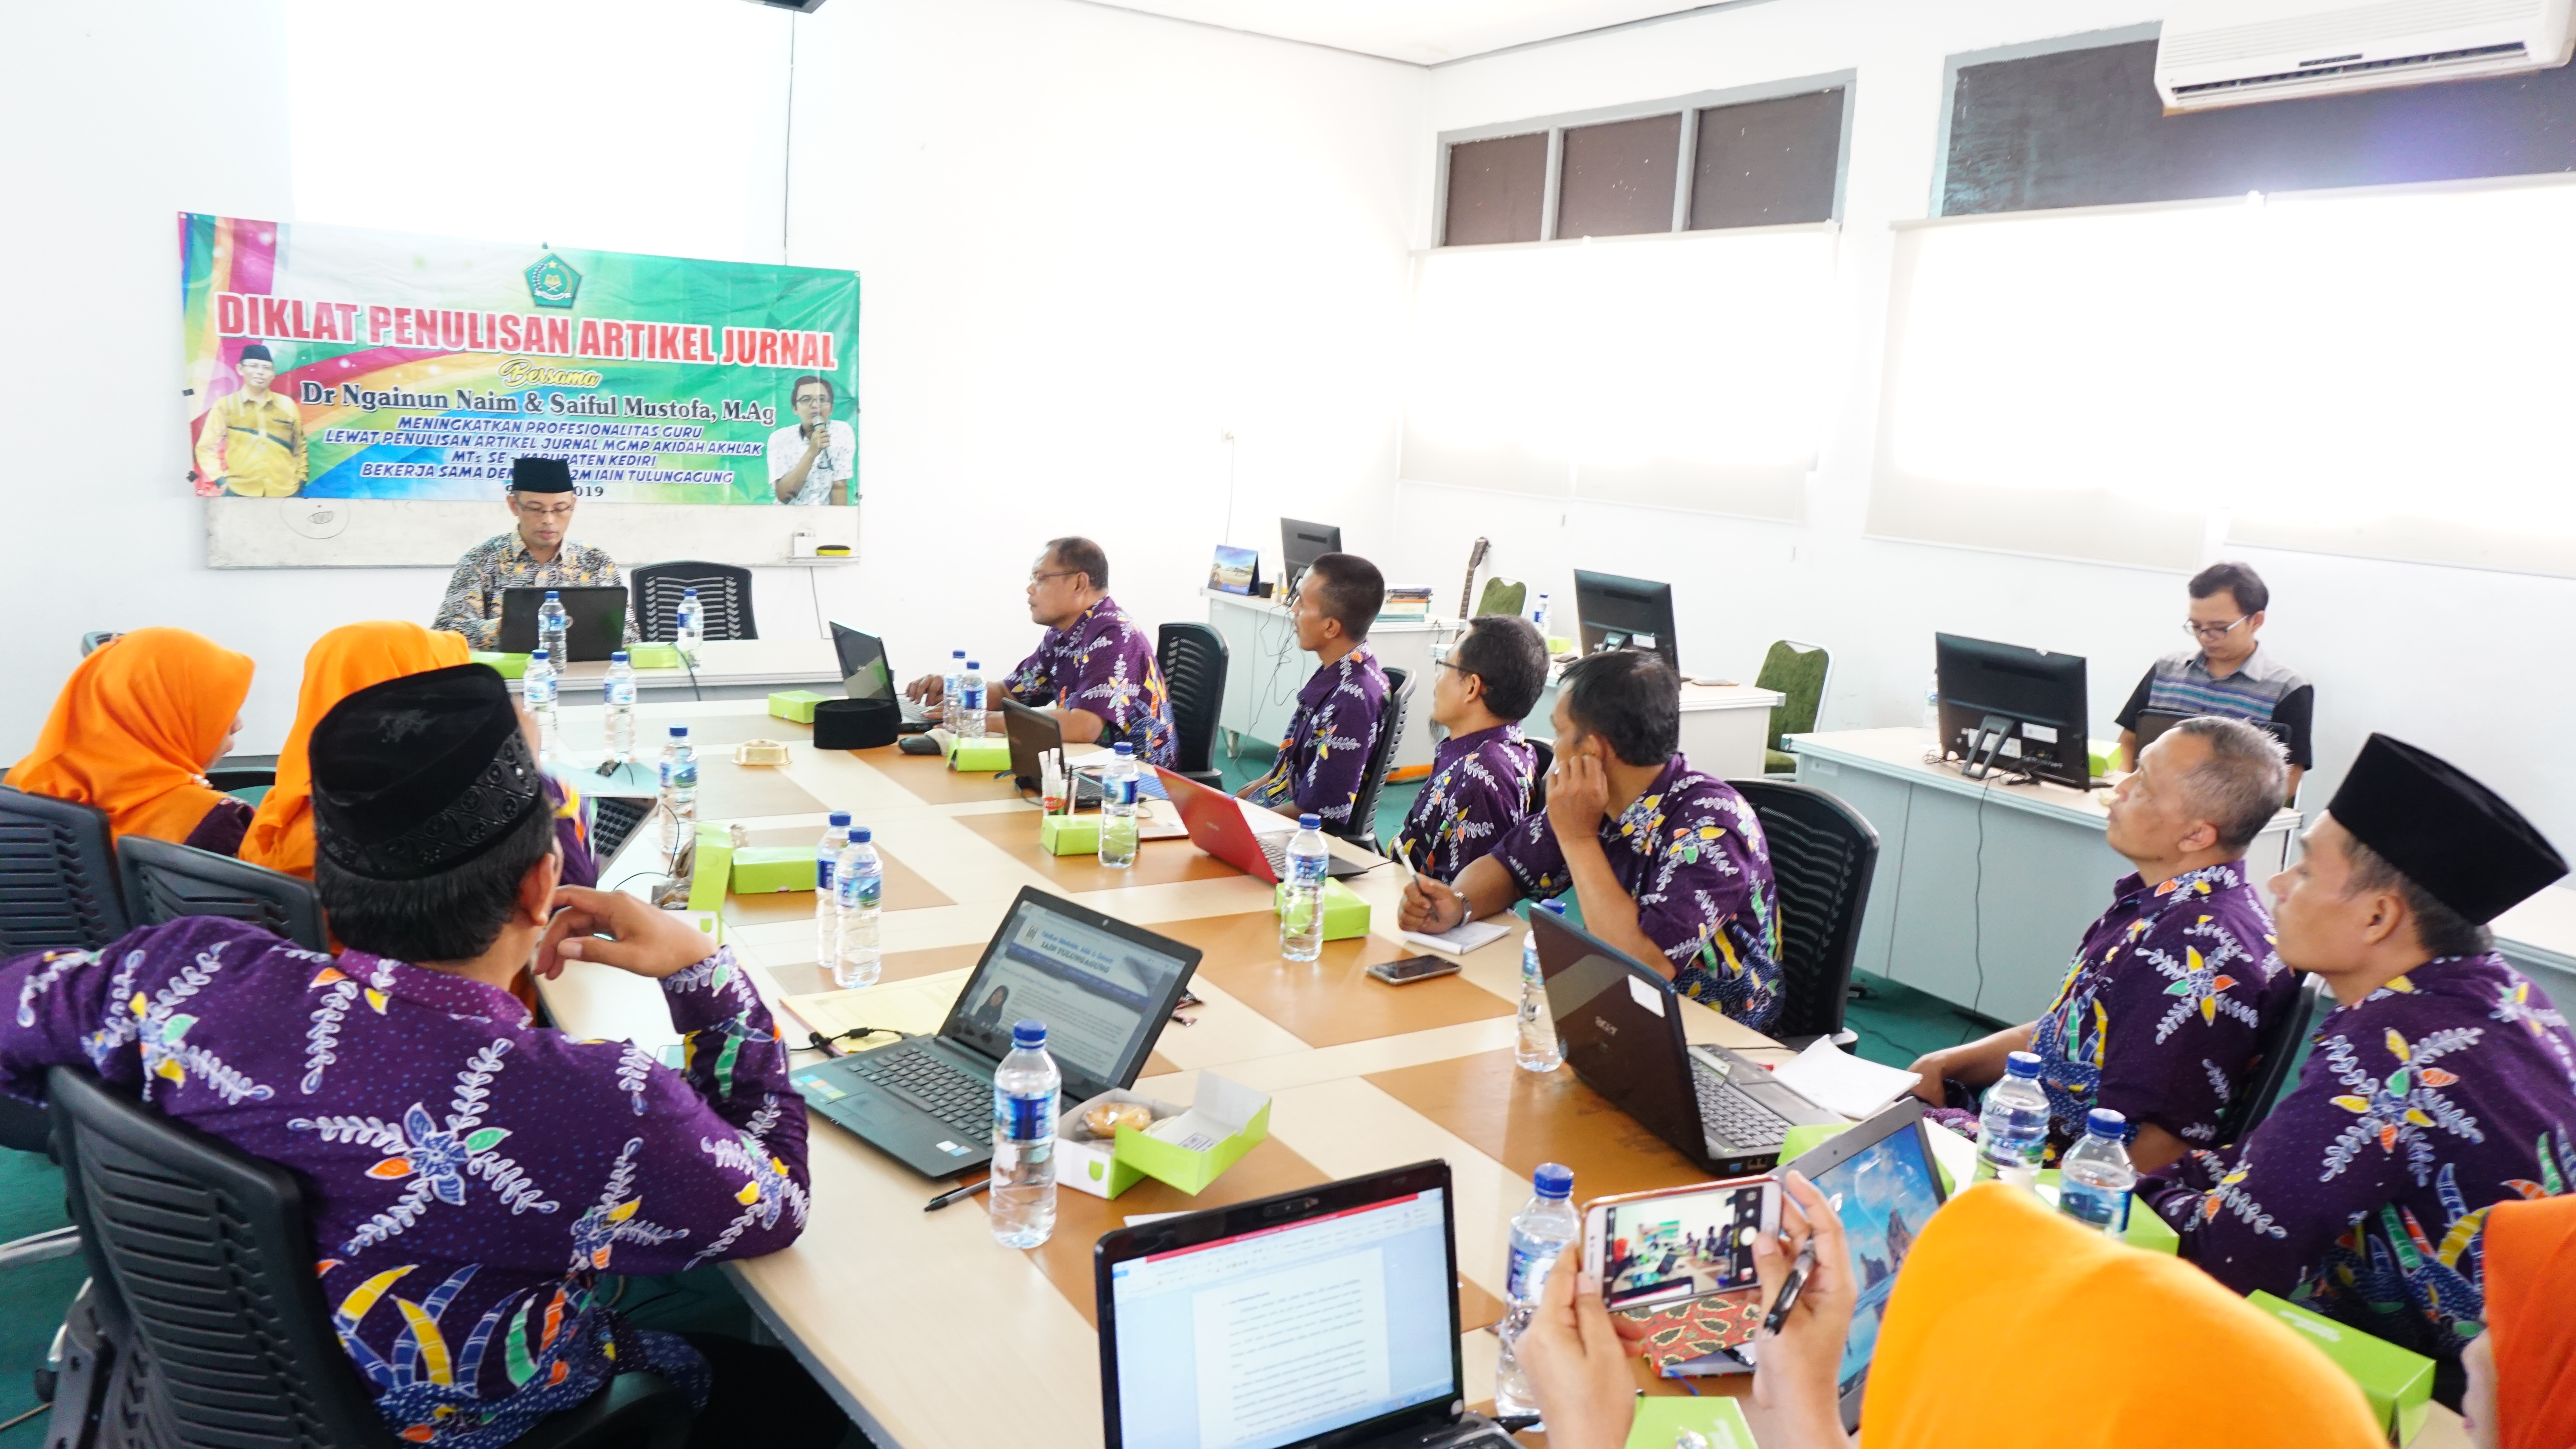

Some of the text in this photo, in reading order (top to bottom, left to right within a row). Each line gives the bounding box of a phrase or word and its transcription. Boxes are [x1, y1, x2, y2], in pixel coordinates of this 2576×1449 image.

[216, 294, 836, 368] DIKLAT PENULISAN ARTIKEL JURNAL
[499, 358, 600, 387] Bersama
[302, 382, 776, 425] Dr Ngainun Naim & Saiful Mustofa, M.Ag
[398, 416, 703, 438] MENINGKATKAN PROFESIONALITAS GURU
[325, 429, 763, 455] LEWAT PENULISAN ARTIKEL JURNAL MGMP AKIDAH AKHLAK
[487, 452, 507, 464] SE
[608, 455, 657, 467] KEDIRI
[362, 463, 434, 477] BEKERJA
[438, 465, 482, 478] SAMA
[486, 467, 514, 479] DEN
[595, 469, 624, 481] IAIN
[628, 470, 733, 483] TULUNGAGUNG
[574, 485, 604, 497] 019
